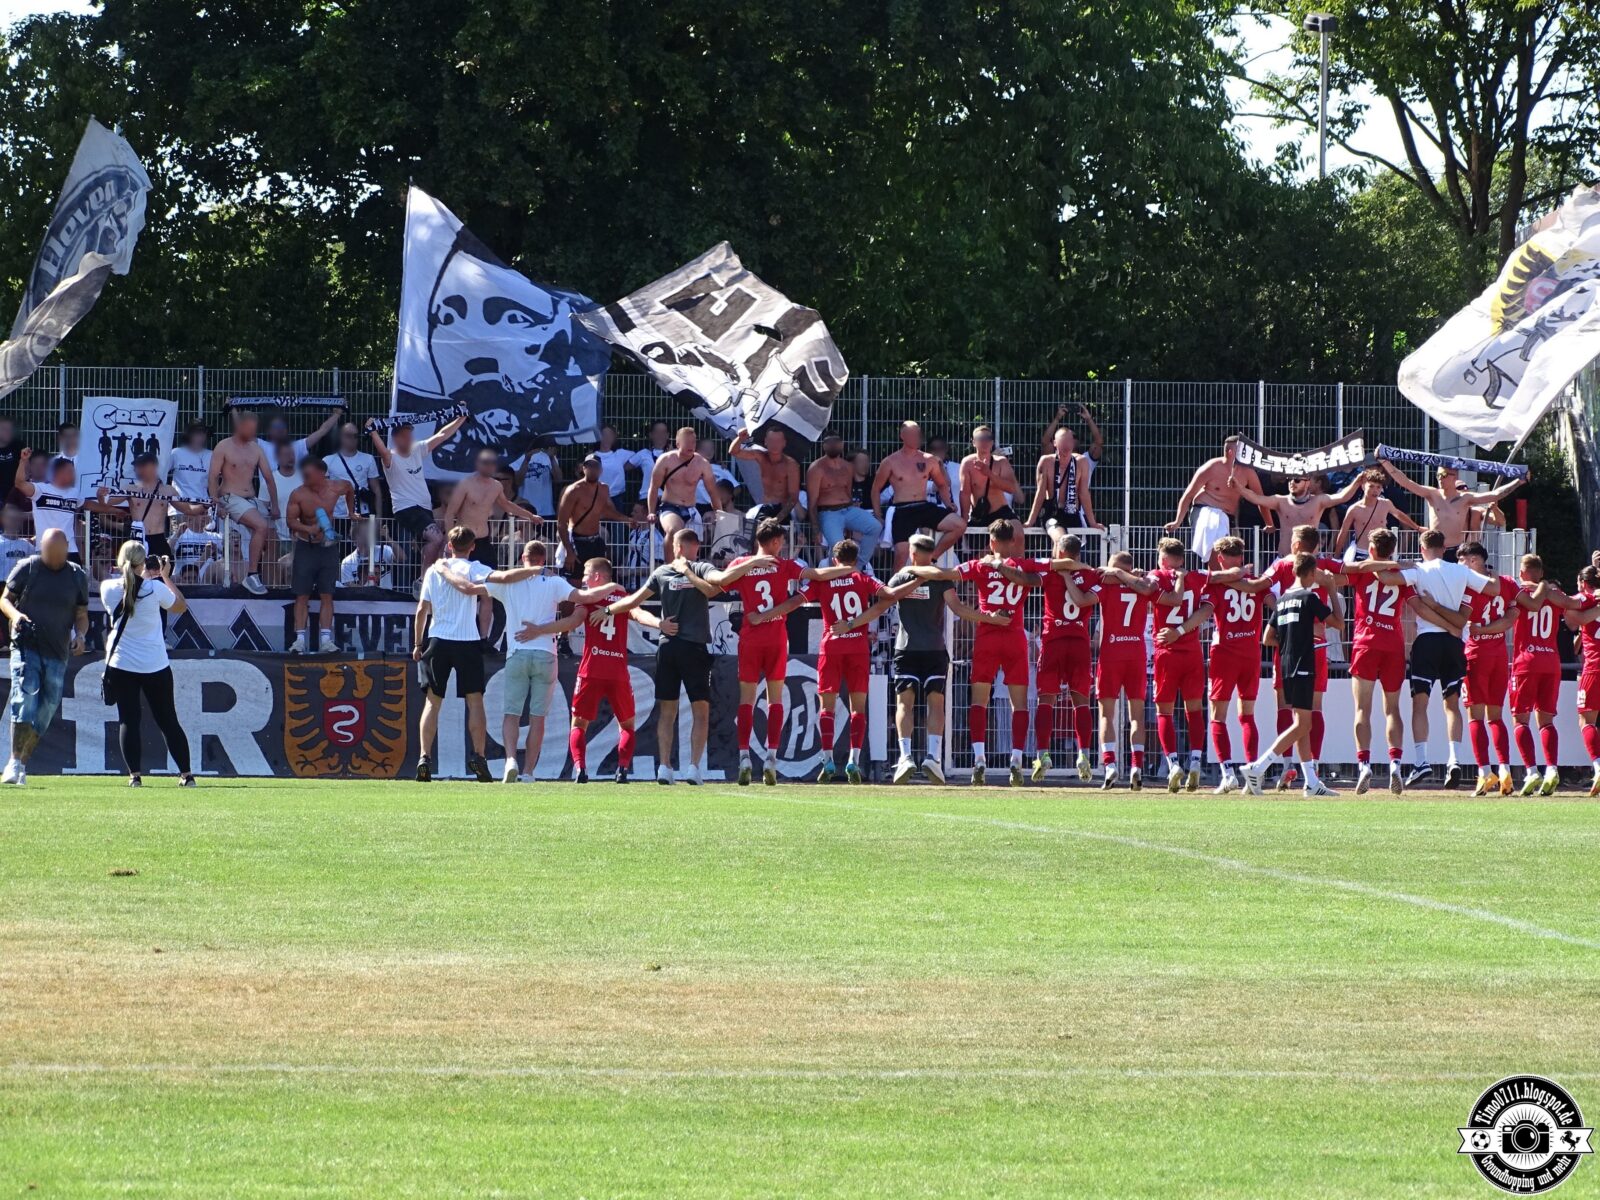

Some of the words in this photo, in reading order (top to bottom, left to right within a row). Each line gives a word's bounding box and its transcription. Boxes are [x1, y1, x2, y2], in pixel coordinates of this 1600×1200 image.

[1236, 438, 1366, 475] ULTRAS
[755, 580, 774, 613] 3
[830, 591, 863, 621] 19
[987, 580, 1024, 605] 20
[1224, 589, 1256, 623] 36
[1365, 580, 1400, 617] 12
[1120, 593, 1137, 627] 7
[1527, 605, 1553, 639] 10
[600, 614, 616, 641] 4
